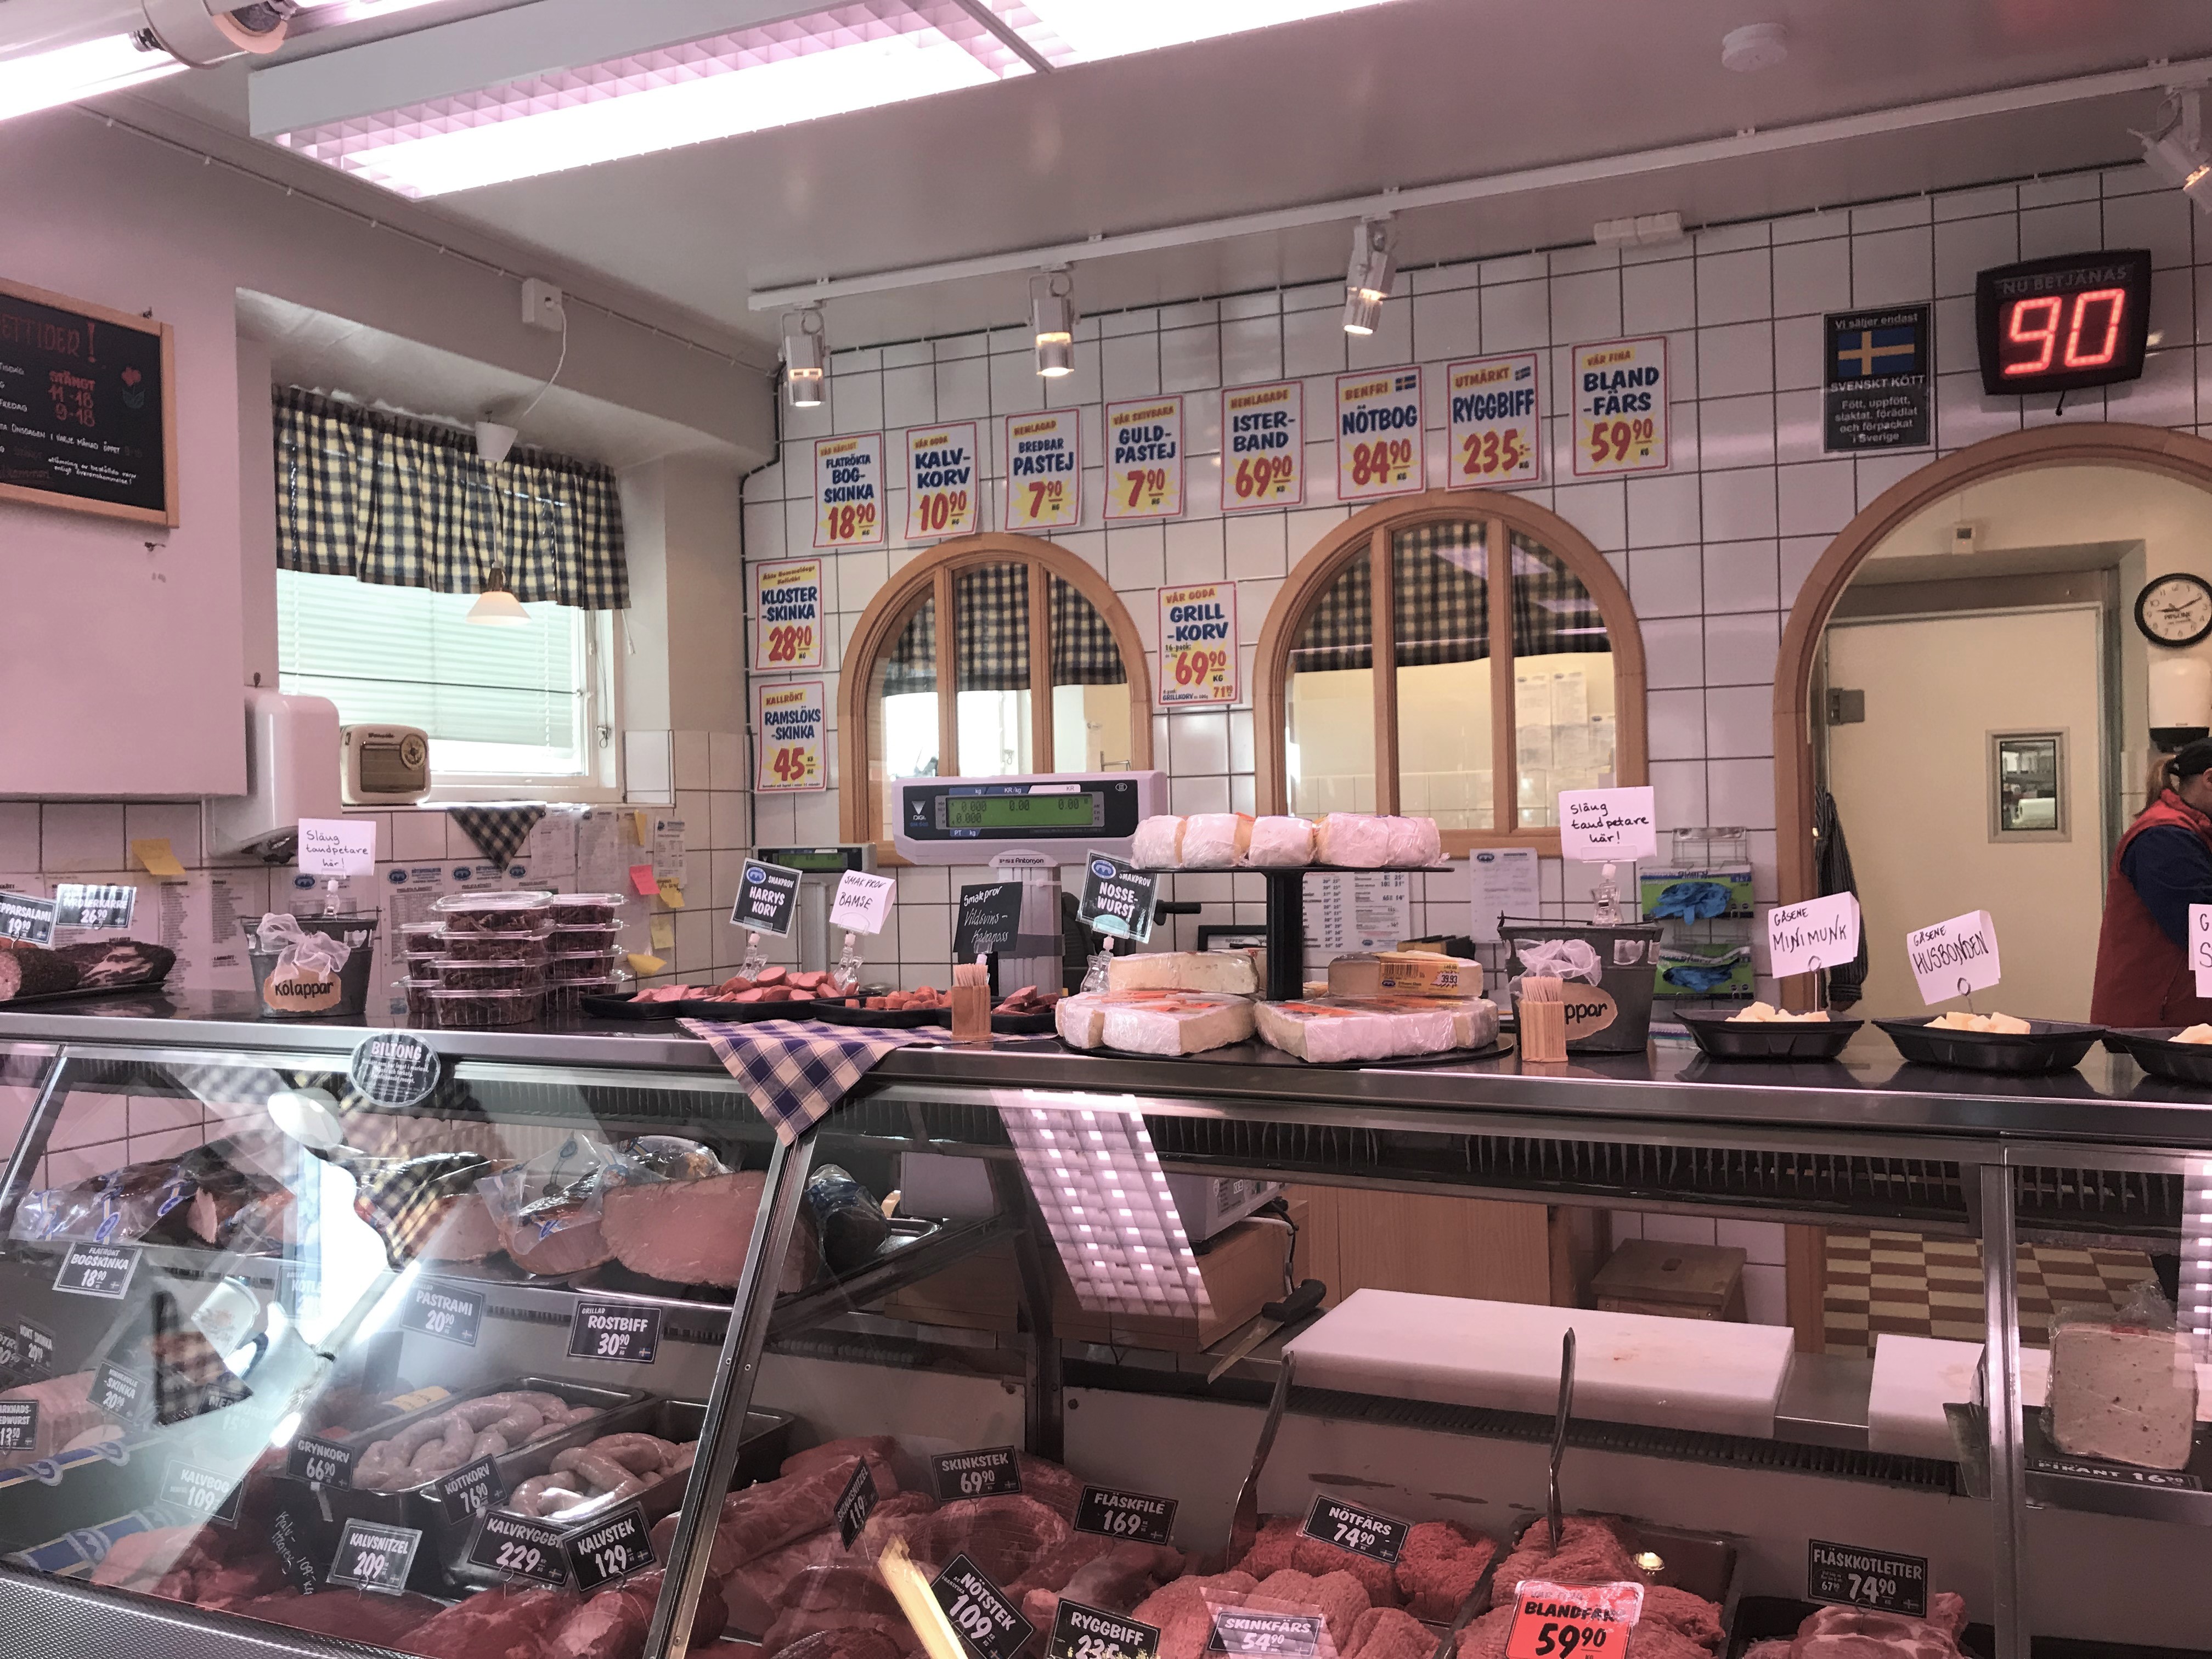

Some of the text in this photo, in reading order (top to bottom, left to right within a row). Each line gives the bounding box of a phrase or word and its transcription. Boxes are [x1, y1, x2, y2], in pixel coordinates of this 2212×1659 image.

[2002, 266, 2128, 294] NU BETJÄNAS
[1835, 319, 1846, 329] Vi
[1880, 313, 1918, 325] endast
[2004, 287, 2126, 375] 90
[1455, 368, 1509, 387] UTMÄRKT
[1583, 366, 1659, 393] BLAND
[1830, 374, 1925, 392] SVENSKT KÖTT
[1345, 381, 1389, 400] BENFRI
[1453, 388, 1534, 424] RYGGBIFF
[1583, 390, 1651, 416] -FÄRS
[1233, 410, 1296, 432] ISTER-
[1342, 404, 1418, 436] NÖTBOG
[1839, 419, 1914, 434] och förpackat
[1018, 437, 1064, 454] BREDBAR
[1119, 425, 1171, 445] GULD-
[1233, 431, 1289, 453] BAND
[915, 447, 971, 470] KALV-
[1115, 441, 1176, 464] PASTEJ
[1013, 451, 1074, 477] PASTEJ
[832, 466, 866, 485] BOG-
[917, 466, 971, 489] KORV
[824, 483, 874, 504] SKINKA
[761, 585, 818, 606] KLOSTER
[1166, 591, 1186, 603] VÅR
[761, 603, 816, 622] -SKINKA
[1170, 602, 1225, 623] GRILL
[1167, 621, 1229, 642] -KORV
[1212, 674, 1224, 682] KG
[766, 691, 804, 706] KALLRÖKT
[764, 705, 822, 726] RAMSLÖKS
[771, 724, 815, 741] -SKINKA
[774, 746, 805, 782] 45
[969, 829, 976, 838] kg
[768, 874, 794, 889] SMAKPROV
[1119, 873, 1152, 887] SMAKPROV
[749, 886, 786, 911] HARRYS
[839, 891, 873, 910] BAMSE
[1099, 881, 1139, 904] NOSSE-
[751, 900, 778, 918] KORV
[1097, 895, 1135, 923] WURST
[1912, 930, 1990, 974] HUSBONDEN
[1441, 974, 1458, 984] 39.93
[371, 1041, 422, 1060] BILTONG
[71, 1253, 129, 1270] BOGSKINKA
[416, 1291, 473, 1317] PASTRAMI
[588, 1314, 649, 1333] ROSTBIFF
[297, 1440, 349, 1464] GRYNKORV
[941, 1452, 1009, 1472] SKINKSTEK
[180, 1468, 229, 1493] KALVBOG
[444, 1462, 490, 1496] KÖTTKORV
[1094, 1492, 1165, 1515] FLÄSKFILÉ
[1103, 1509, 1142, 1536] 169
[1328, 1506, 1392, 1536] NÖTFÄRS
[350, 1532, 409, 1555] KALVSNITZEL
[577, 1517, 635, 1556] KALVSTEK
[496, 1541, 541, 1573] 229
[595, 1544, 627, 1578] 129
[1814, 1547, 1923, 1581] FLÄSKKOTLETTER
[960, 1572, 1017, 1632] NÖTSTEK
[949, 1594, 993, 1639] 109
[1224, 1618, 1312, 1634] SKINKFÄRS
[1070, 1611, 1144, 1646] RYGGBIFF
